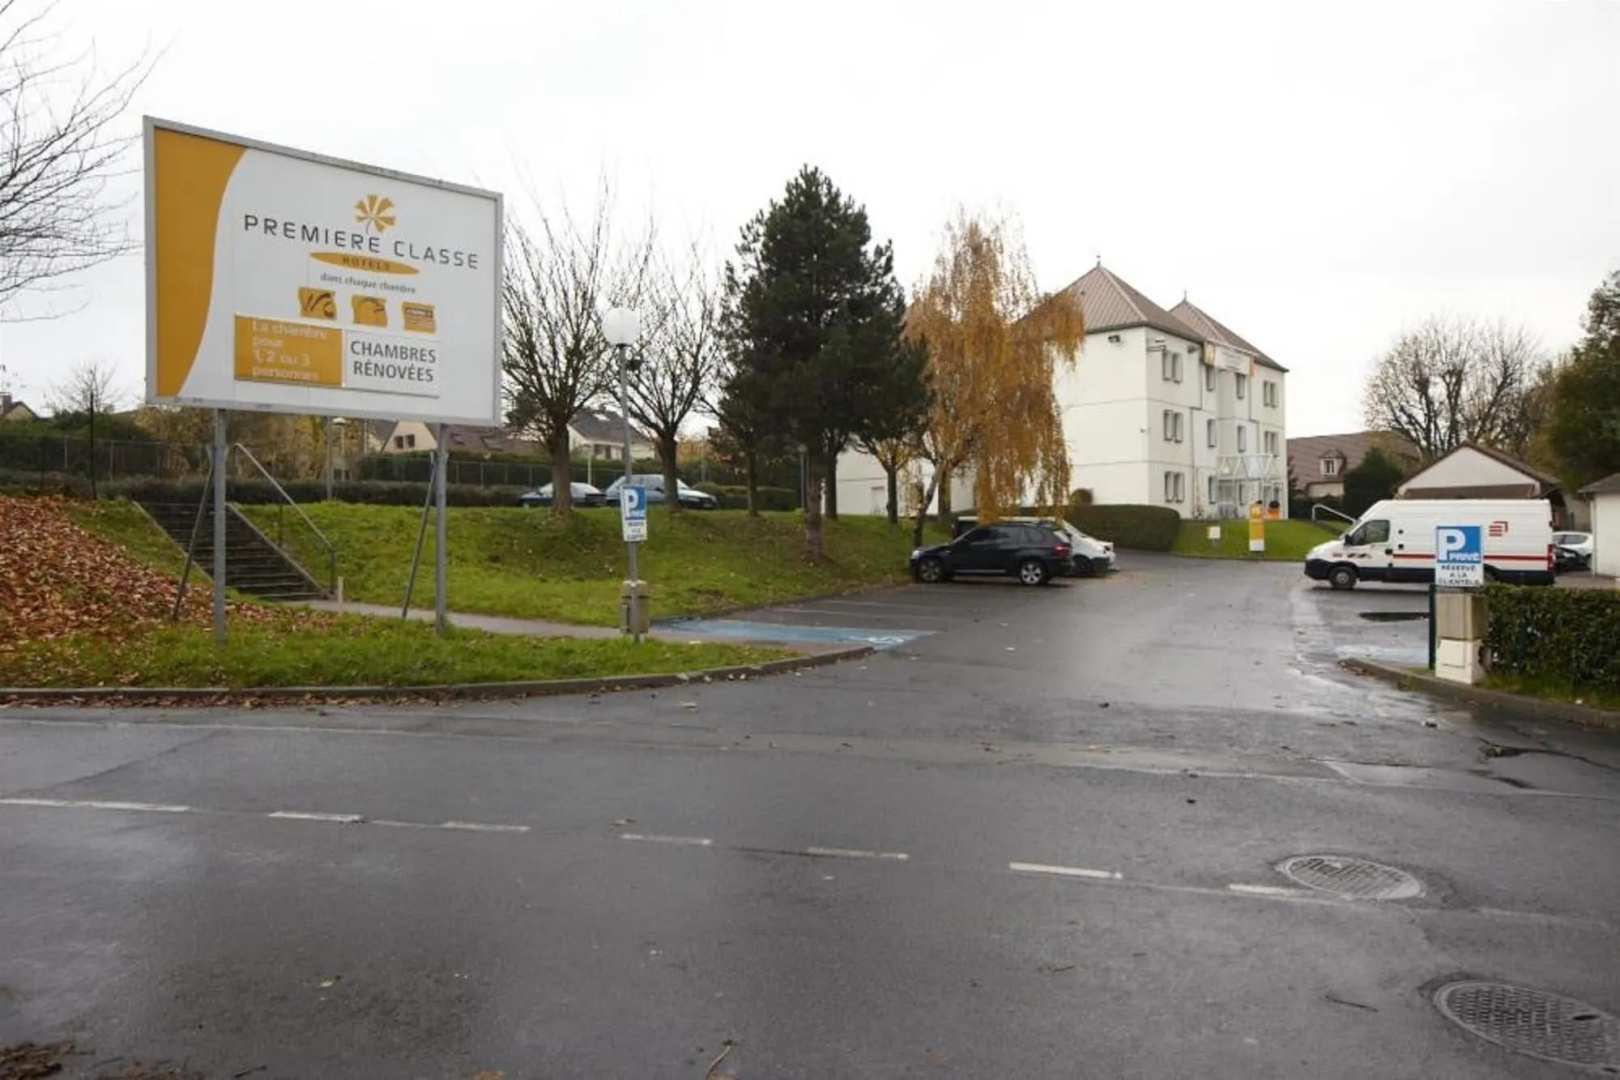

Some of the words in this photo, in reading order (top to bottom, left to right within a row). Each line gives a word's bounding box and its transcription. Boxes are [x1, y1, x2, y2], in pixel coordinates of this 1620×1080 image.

[243, 214, 381, 254] PREMIERE
[393, 240, 479, 270] CLASSE
[266, 350, 276, 363] 2
[301, 353, 311, 368] 3
[350, 340, 437, 364] CHAMBRES
[353, 359, 435, 383] RÉNOVÉES
[1438, 529, 1466, 560] P
